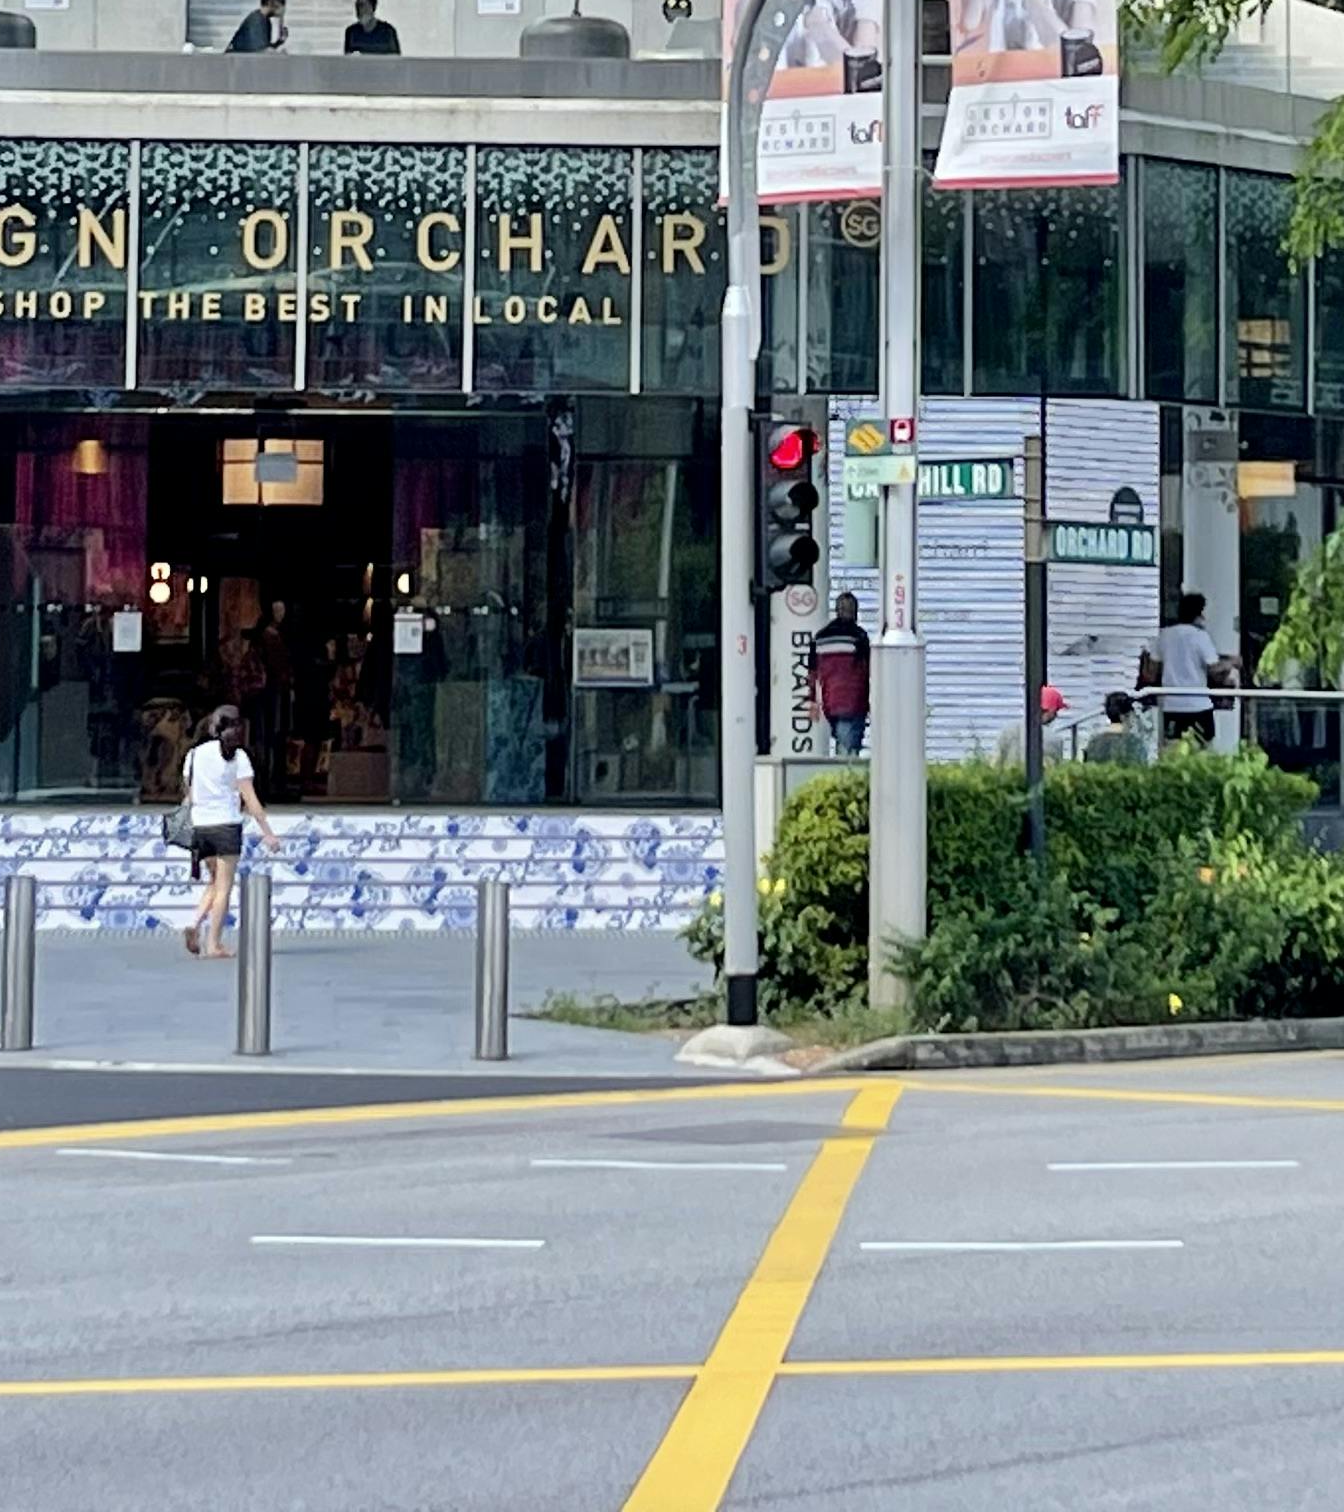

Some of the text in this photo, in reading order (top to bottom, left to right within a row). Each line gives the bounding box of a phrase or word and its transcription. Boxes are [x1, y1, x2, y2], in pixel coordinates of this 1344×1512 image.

[242, 207, 792, 276] ORCHARD
[847, 213, 880, 238] SG
[138, 291, 222, 321] THE
[244, 292, 362, 323] BEST
[403, 295, 448, 324] IN
[472, 295, 623, 325] LOCAL
[971, 462, 1003, 495] RD
[1056, 524, 1153, 560] ORCHARD RD
[791, 631, 813, 754] BRANDS
